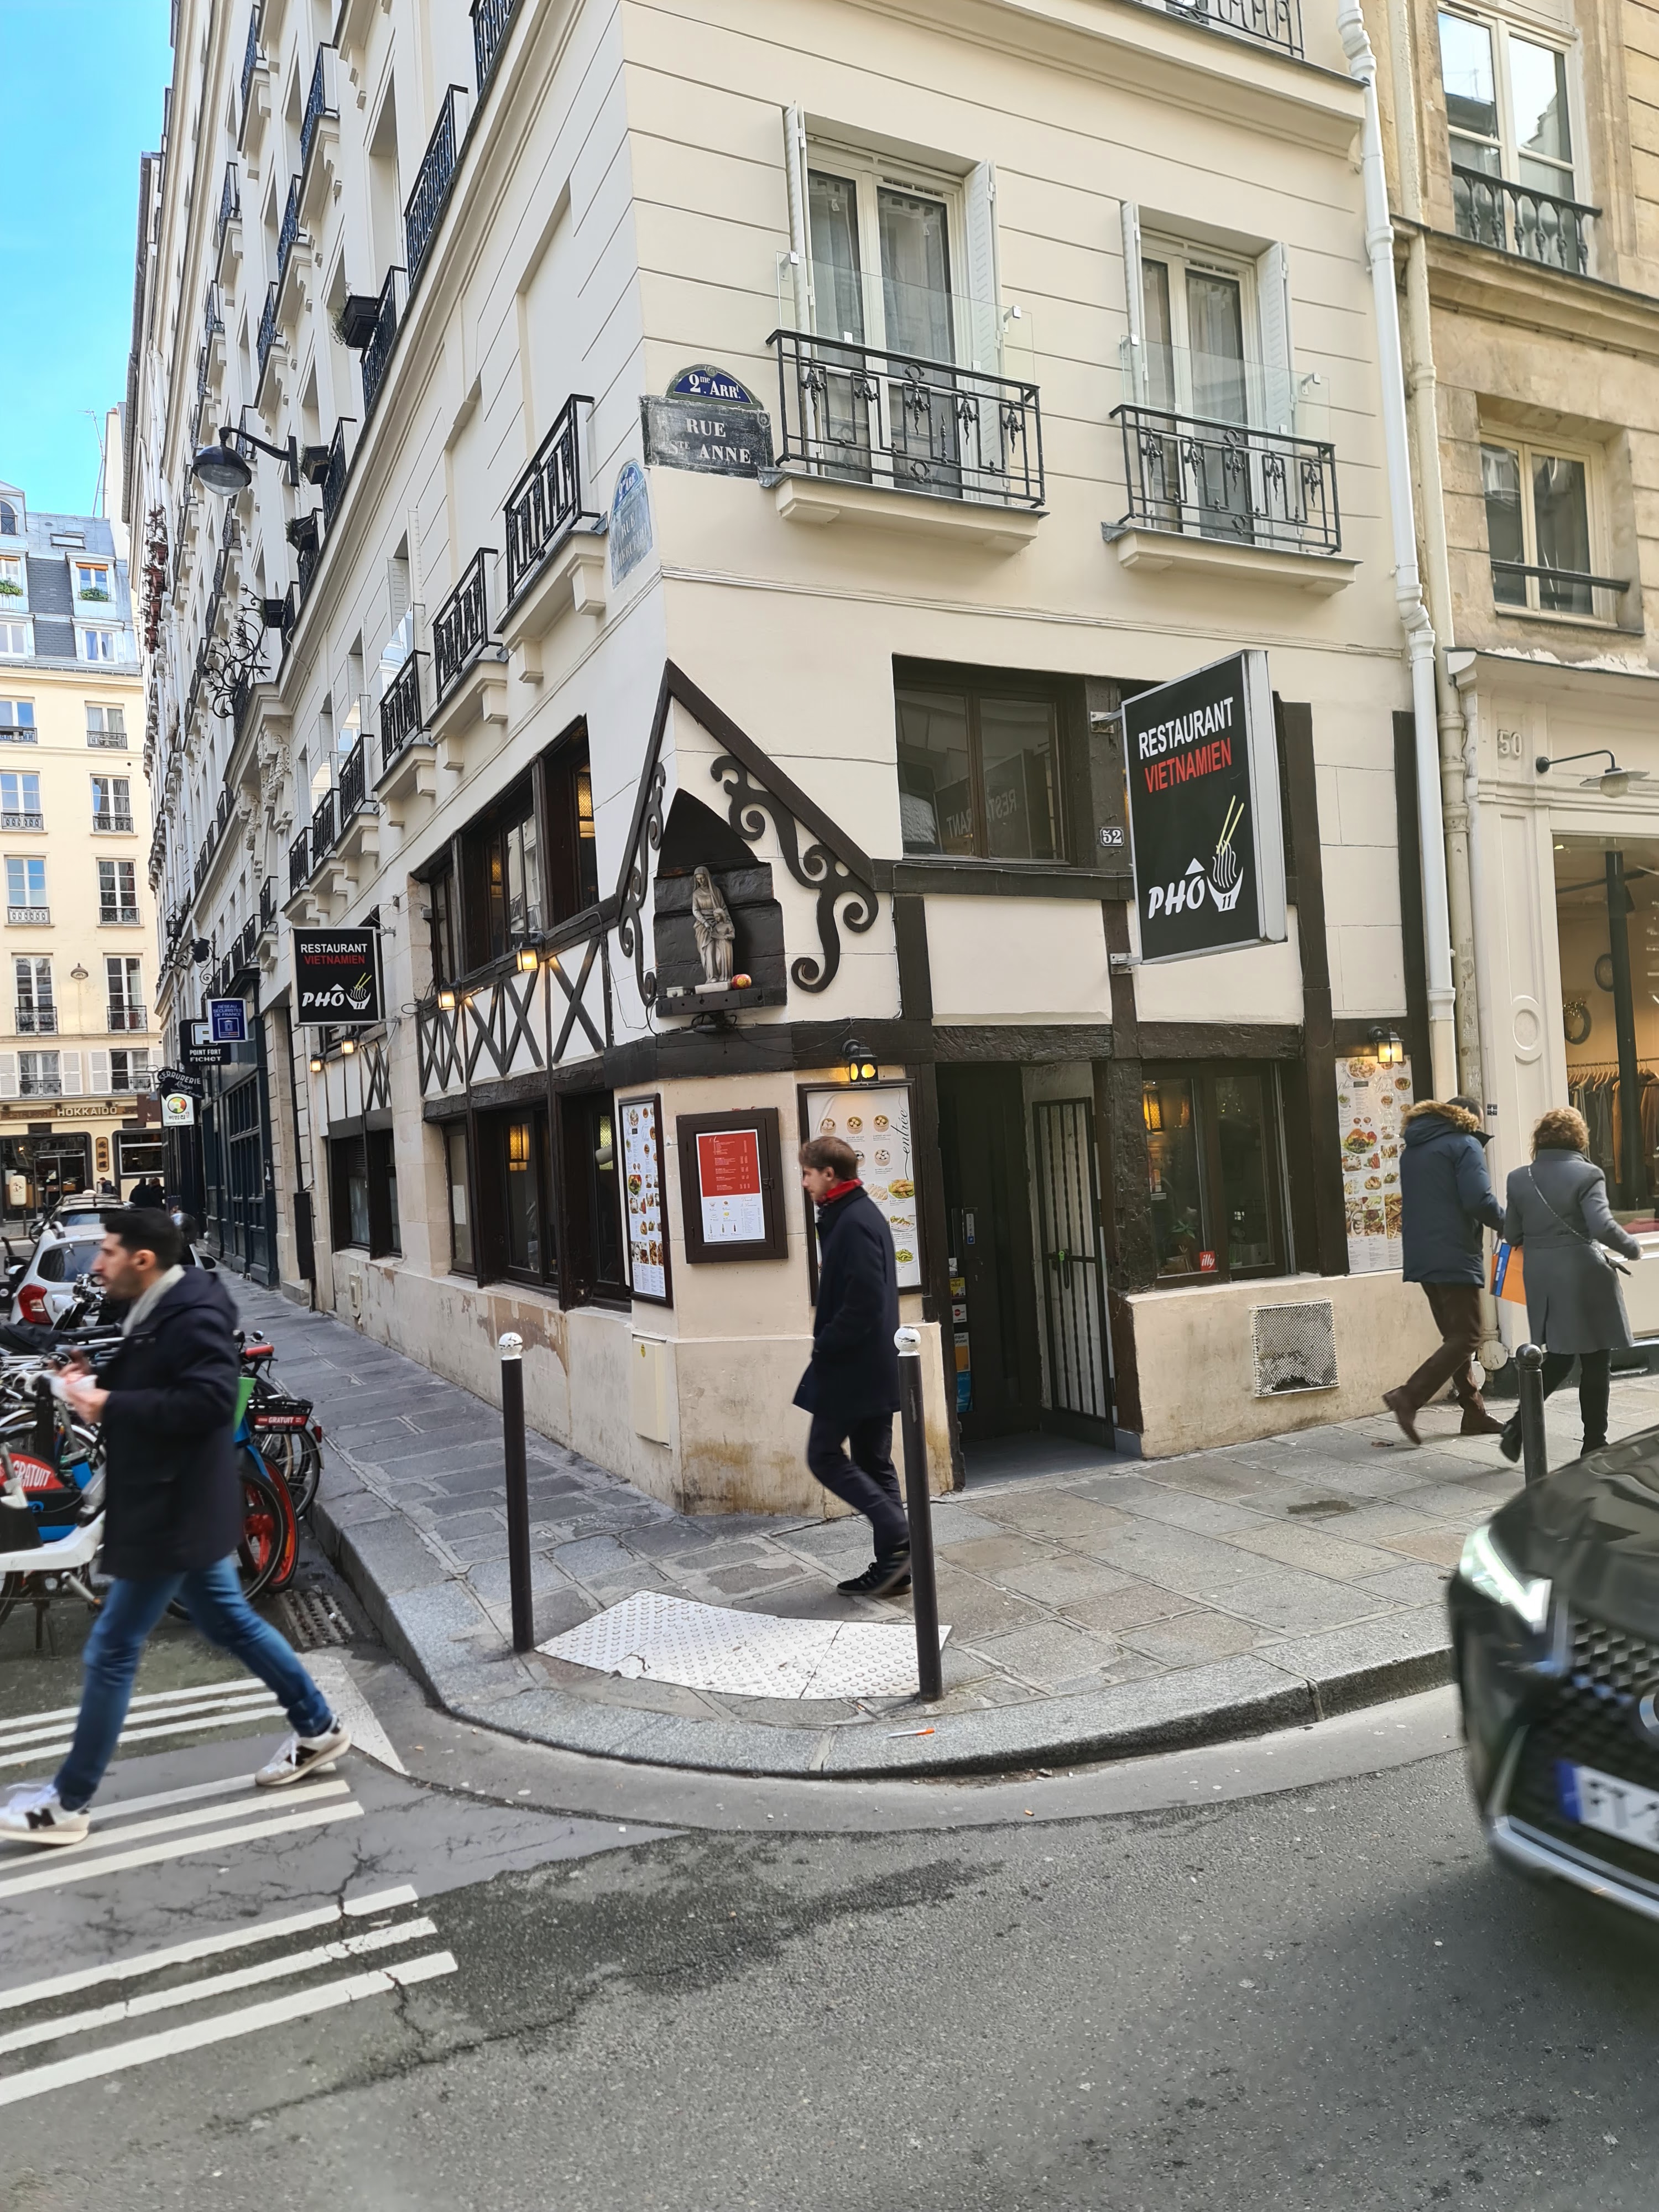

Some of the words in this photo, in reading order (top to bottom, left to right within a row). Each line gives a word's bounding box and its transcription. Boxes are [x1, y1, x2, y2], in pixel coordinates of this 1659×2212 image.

[685, 418, 726, 437] RUE
[1138, 697, 1234, 760] RESTAURANT
[1498, 729, 1522, 757] 50
[1145, 738, 1232, 793] VIETNAMIEN
[1103, 830, 1122, 844] 52
[1220, 894, 1233, 910] 11
[300, 943, 367, 953] RESTAURANT
[304, 955, 365, 964] VIETNAMIEN
[159, 1071, 201, 1084] SERRURERIE
[57, 1107, 117, 1117] HOKKAIDO
[891, 1110, 910, 1154] entrée
[1201, 1254, 1215, 1269] illy
